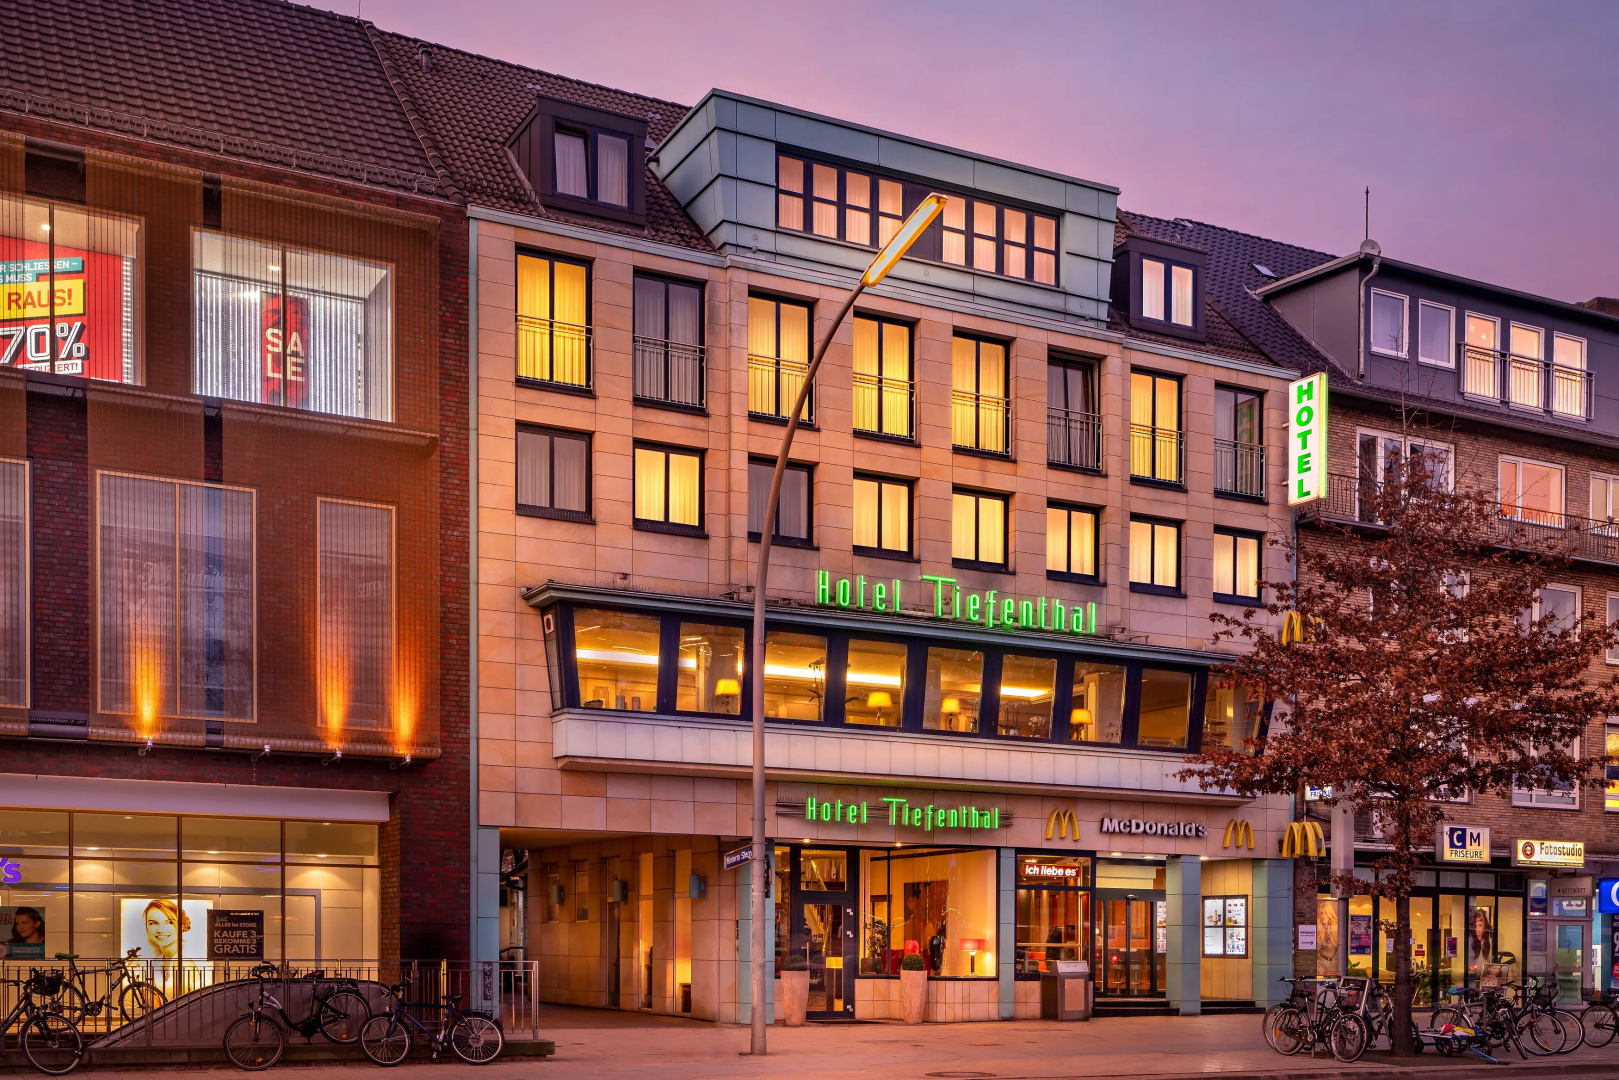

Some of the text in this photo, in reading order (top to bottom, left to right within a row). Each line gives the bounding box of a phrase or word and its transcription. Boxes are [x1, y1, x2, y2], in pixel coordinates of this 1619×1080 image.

[6, 273, 33, 283] MUSS
[8, 288, 73, 311] RAUS!
[1296, 381, 1314, 499] HOTEL
[815, 569, 1097, 634] Hotel Tiefenthal
[806, 797, 999, 831] Hotel Tiefenthal
[1101, 817, 1208, 837] McDonald's
[1450, 849, 1484, 859] FRISEURE
[1539, 842, 1583, 857] Fotostudio
[1025, 864, 1040, 875] ich
[1041, 865, 1064, 876] liebe
[213, 930, 248, 938] KAUFE
[213, 944, 257, 954] GRATIS
